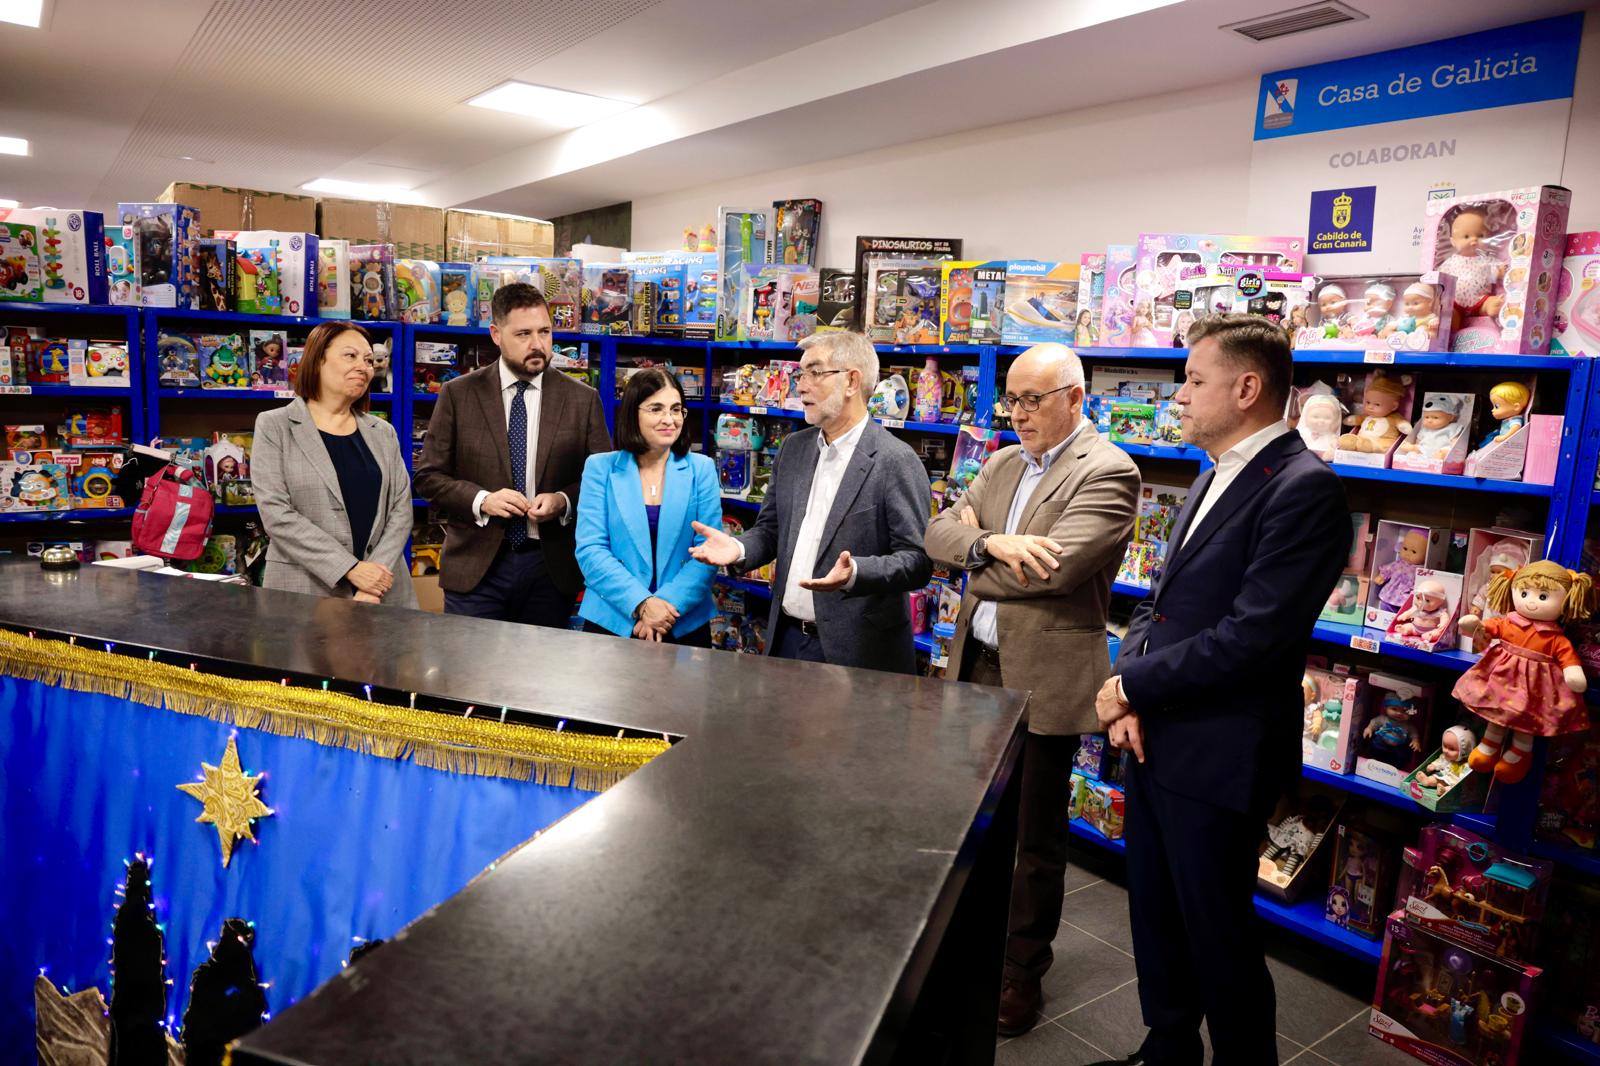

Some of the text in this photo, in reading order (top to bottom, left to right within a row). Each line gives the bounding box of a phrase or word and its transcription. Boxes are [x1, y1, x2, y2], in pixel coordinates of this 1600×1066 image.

[1317, 52, 1538, 107] Casa de Galicia
[1328, 139, 1457, 169] COLABORAN
[1316, 230, 1362, 241] Cabildo de
[872, 240, 933, 250] DINOSAURIOS
[1312, 239, 1367, 250] Gran Canaria
[663, 255, 704, 265] RACING
[1008, 264, 1047, 273] playmobil
